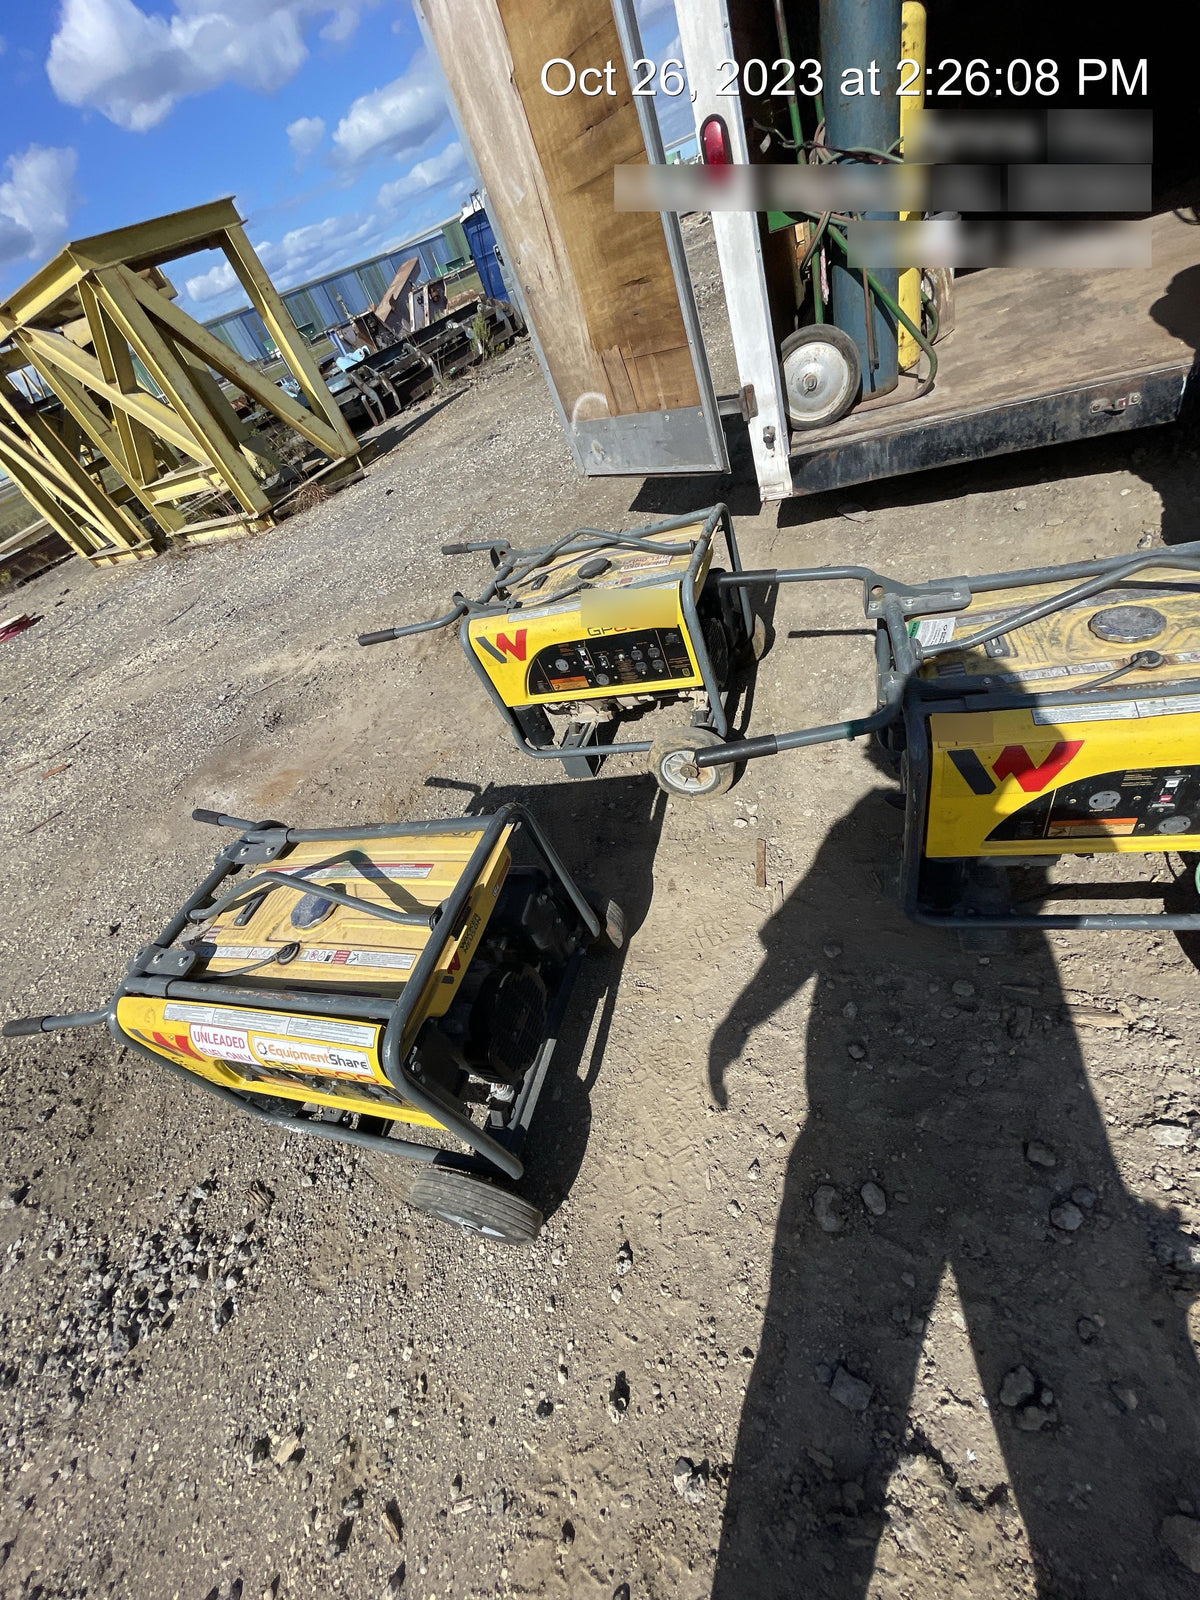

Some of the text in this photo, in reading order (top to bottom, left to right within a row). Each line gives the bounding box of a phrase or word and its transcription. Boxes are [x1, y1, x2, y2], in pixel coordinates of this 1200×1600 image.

[193, 1031, 245, 1049] UNLEADED
[199, 1047, 254, 1062] FUEL ONLY
[268, 1044, 368, 1070] EquipmentShare
